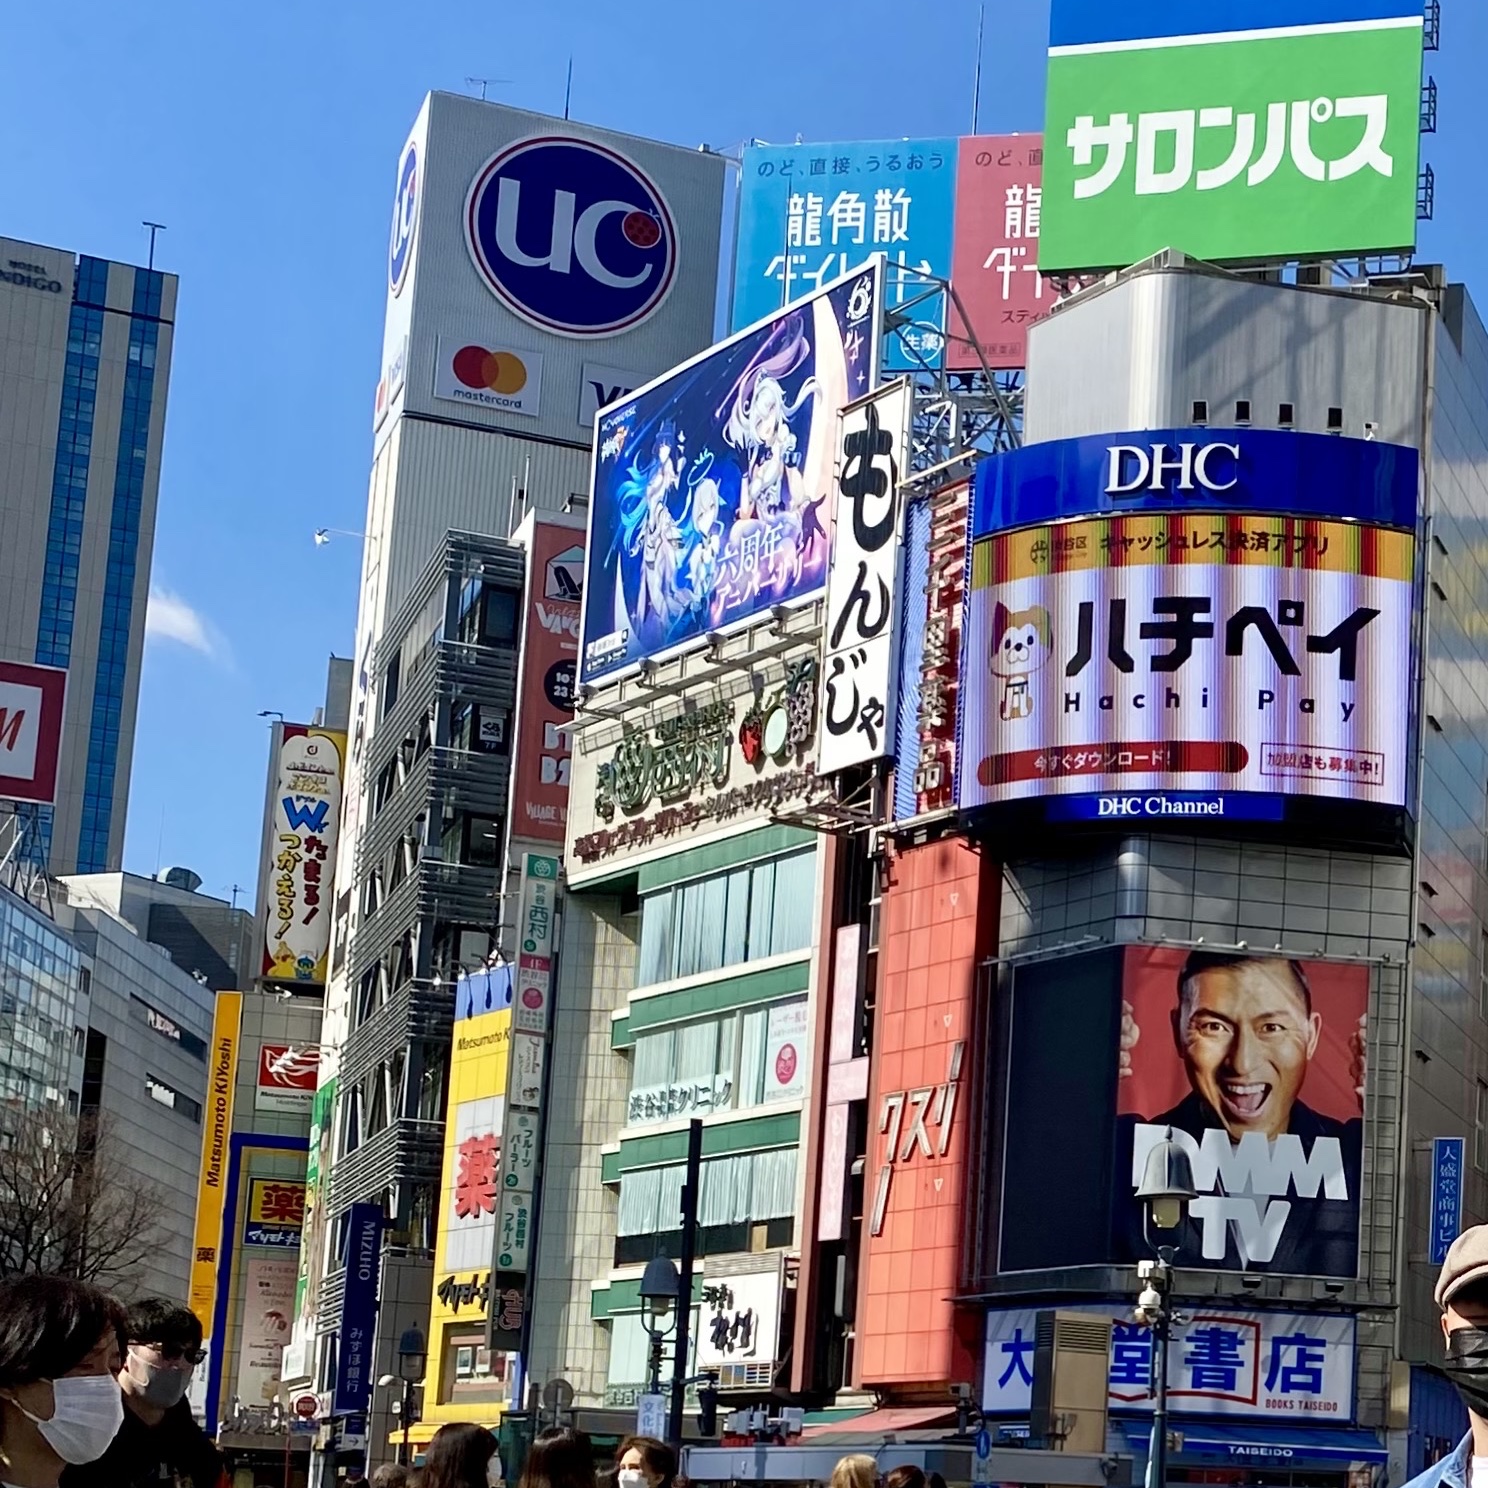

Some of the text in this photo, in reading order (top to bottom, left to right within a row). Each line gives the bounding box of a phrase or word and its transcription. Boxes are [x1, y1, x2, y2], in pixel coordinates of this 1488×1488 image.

[757, 152, 945, 178] のど、直接、うるおう
[975, 149, 1043, 167] のど、直
[1066, 93, 1395, 200] サロンパス
[788, 187, 912, 248] 龍角散
[1004, 184, 1043, 239] 龍
[0, 269, 61, 293] NDIGO
[763, 250, 933, 303] ダイト
[904, 333, 943, 352] 生薬
[453, 388, 522, 409] mastercard
[1105, 443, 1240, 493] DHC
[714, 522, 783, 588] 六周年
[825, 403, 896, 751] もんじゃ
[1066, 597, 1381, 681] ハチペイ
[1065, 687, 1356, 723] Hachi Pay
[1098, 796, 1225, 816] DHC Channel
[457, 1031, 502, 1051] Matsumoto
[206, 1096, 227, 1188] Matsumoto
[510, 1133, 520, 1173] パーラー
[522, 1129, 533, 1168] フルーツ
[1131, 1122, 1349, 1200] DMM
[455, 1134, 500, 1220] 薬
[261, 1184, 305, 1222] 薬
[358, 1220, 376, 1281] MIZUHO
[503, 1212, 514, 1252] フルーツ
[1188, 1195, 1291, 1263] TV
[196, 1247, 216, 1264] 薬
[346, 1327, 363, 1393] みずほ銀行
[998, 1326, 1327, 1395] 大堂書店
[1265, 1398, 1338, 1412] BOOKS TAISEIDO
[1228, 1445, 1294, 1458] TAISEIDO
